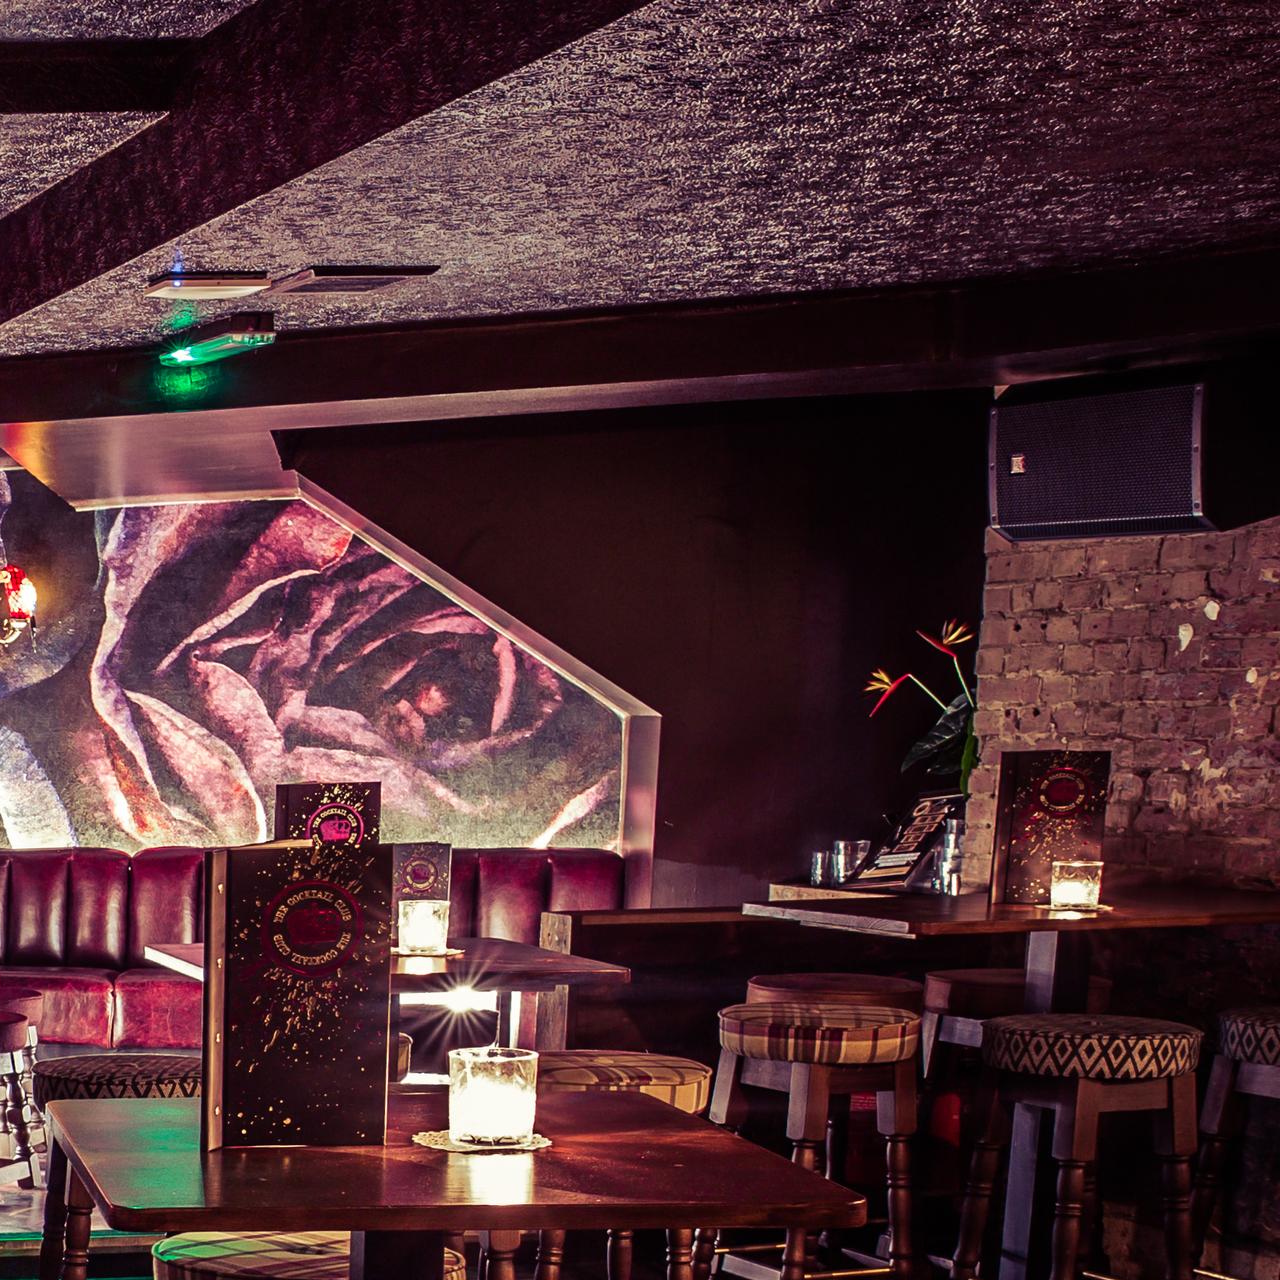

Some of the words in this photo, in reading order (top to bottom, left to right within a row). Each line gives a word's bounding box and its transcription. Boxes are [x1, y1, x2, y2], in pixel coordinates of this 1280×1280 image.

[273, 905, 288, 923] THE
[287, 890, 334, 906] COCKTAIL
[334, 900, 352, 921] CLUB
[274, 934, 291, 956] CLUB
[336, 932, 351, 950] THE
